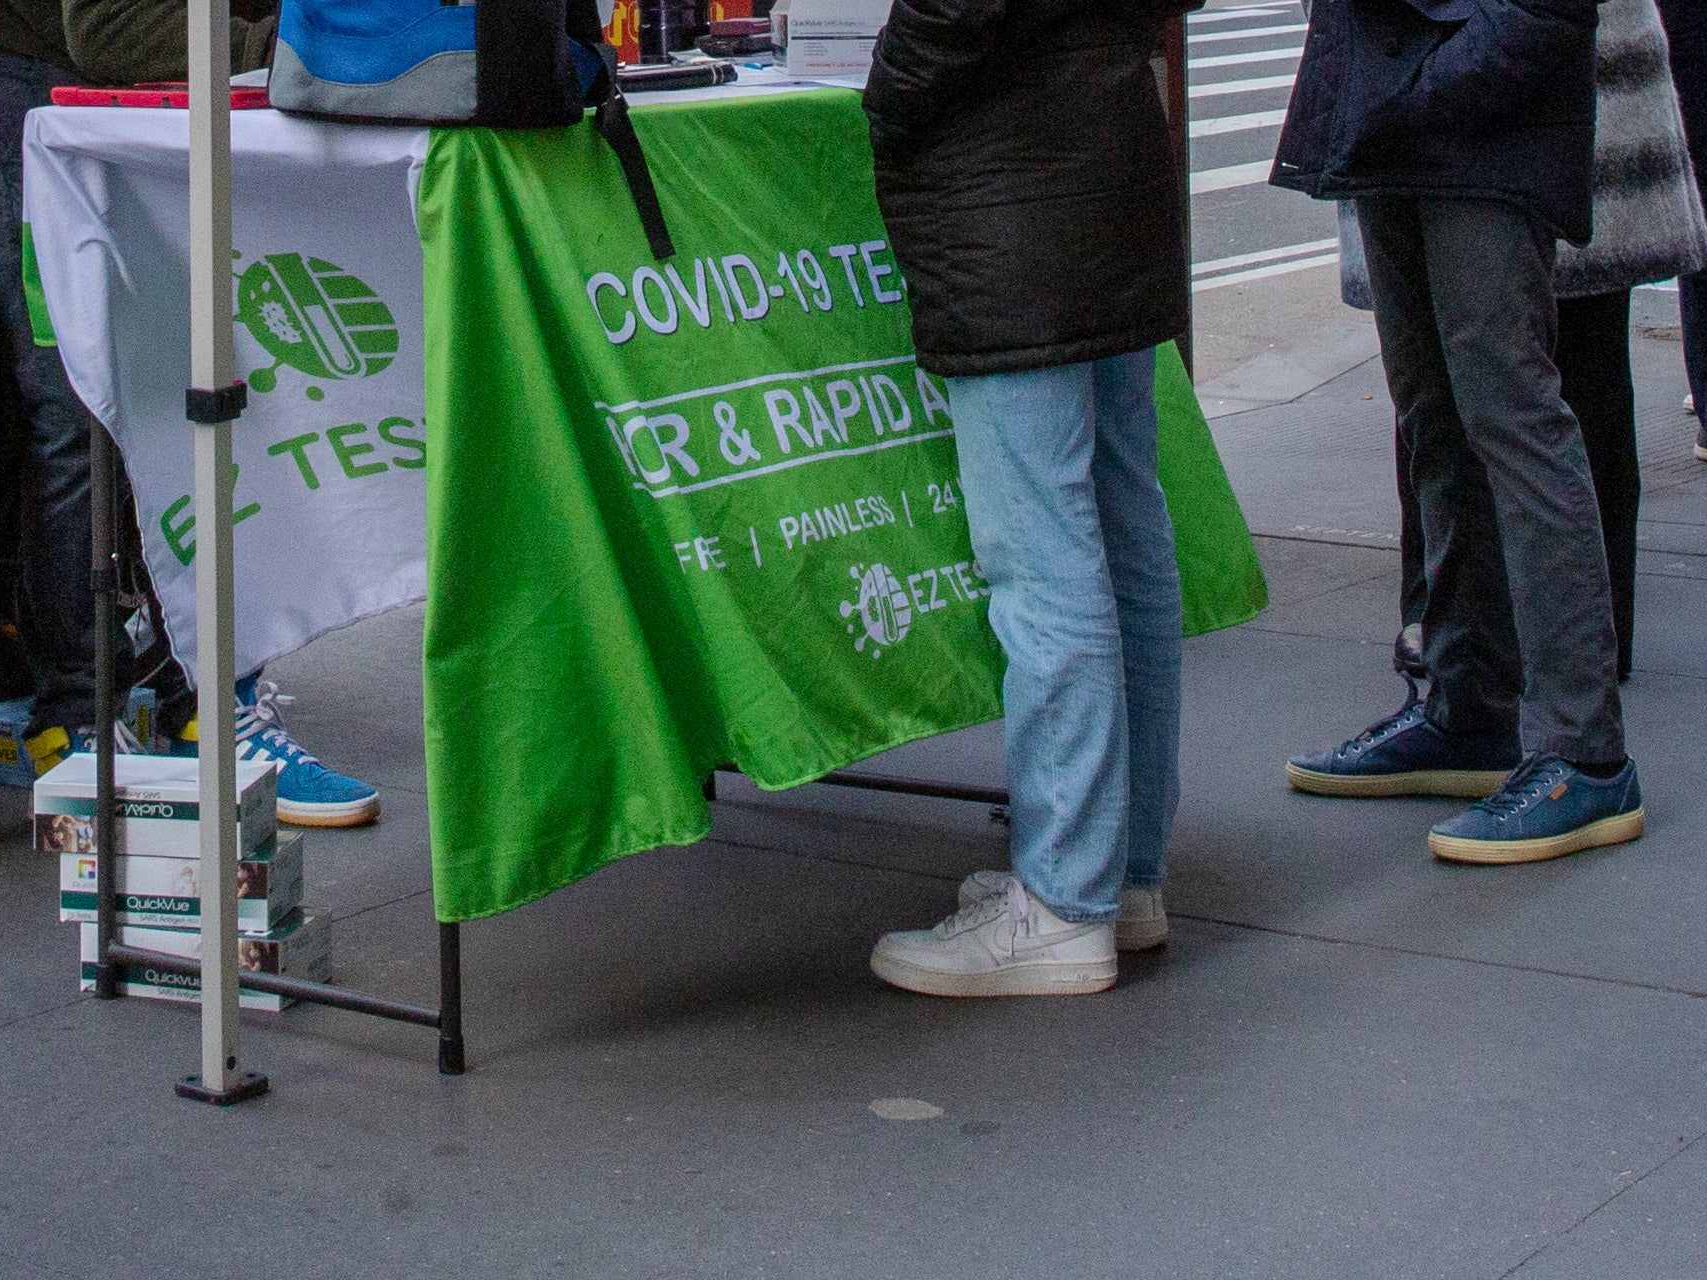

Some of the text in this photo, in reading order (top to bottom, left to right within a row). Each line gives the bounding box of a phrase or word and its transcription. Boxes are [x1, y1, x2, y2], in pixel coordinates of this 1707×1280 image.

[586, 248, 834, 346] COVID-19
[713, 400, 762, 467] &
[764, 372, 913, 456] RAPID
[266, 416, 426, 490] TES
[779, 494, 895, 550] PAINLESS
[907, 568, 947, 614] EZ
[117, 802, 174, 818] QuickVu
[126, 895, 190, 912] QuickVue
